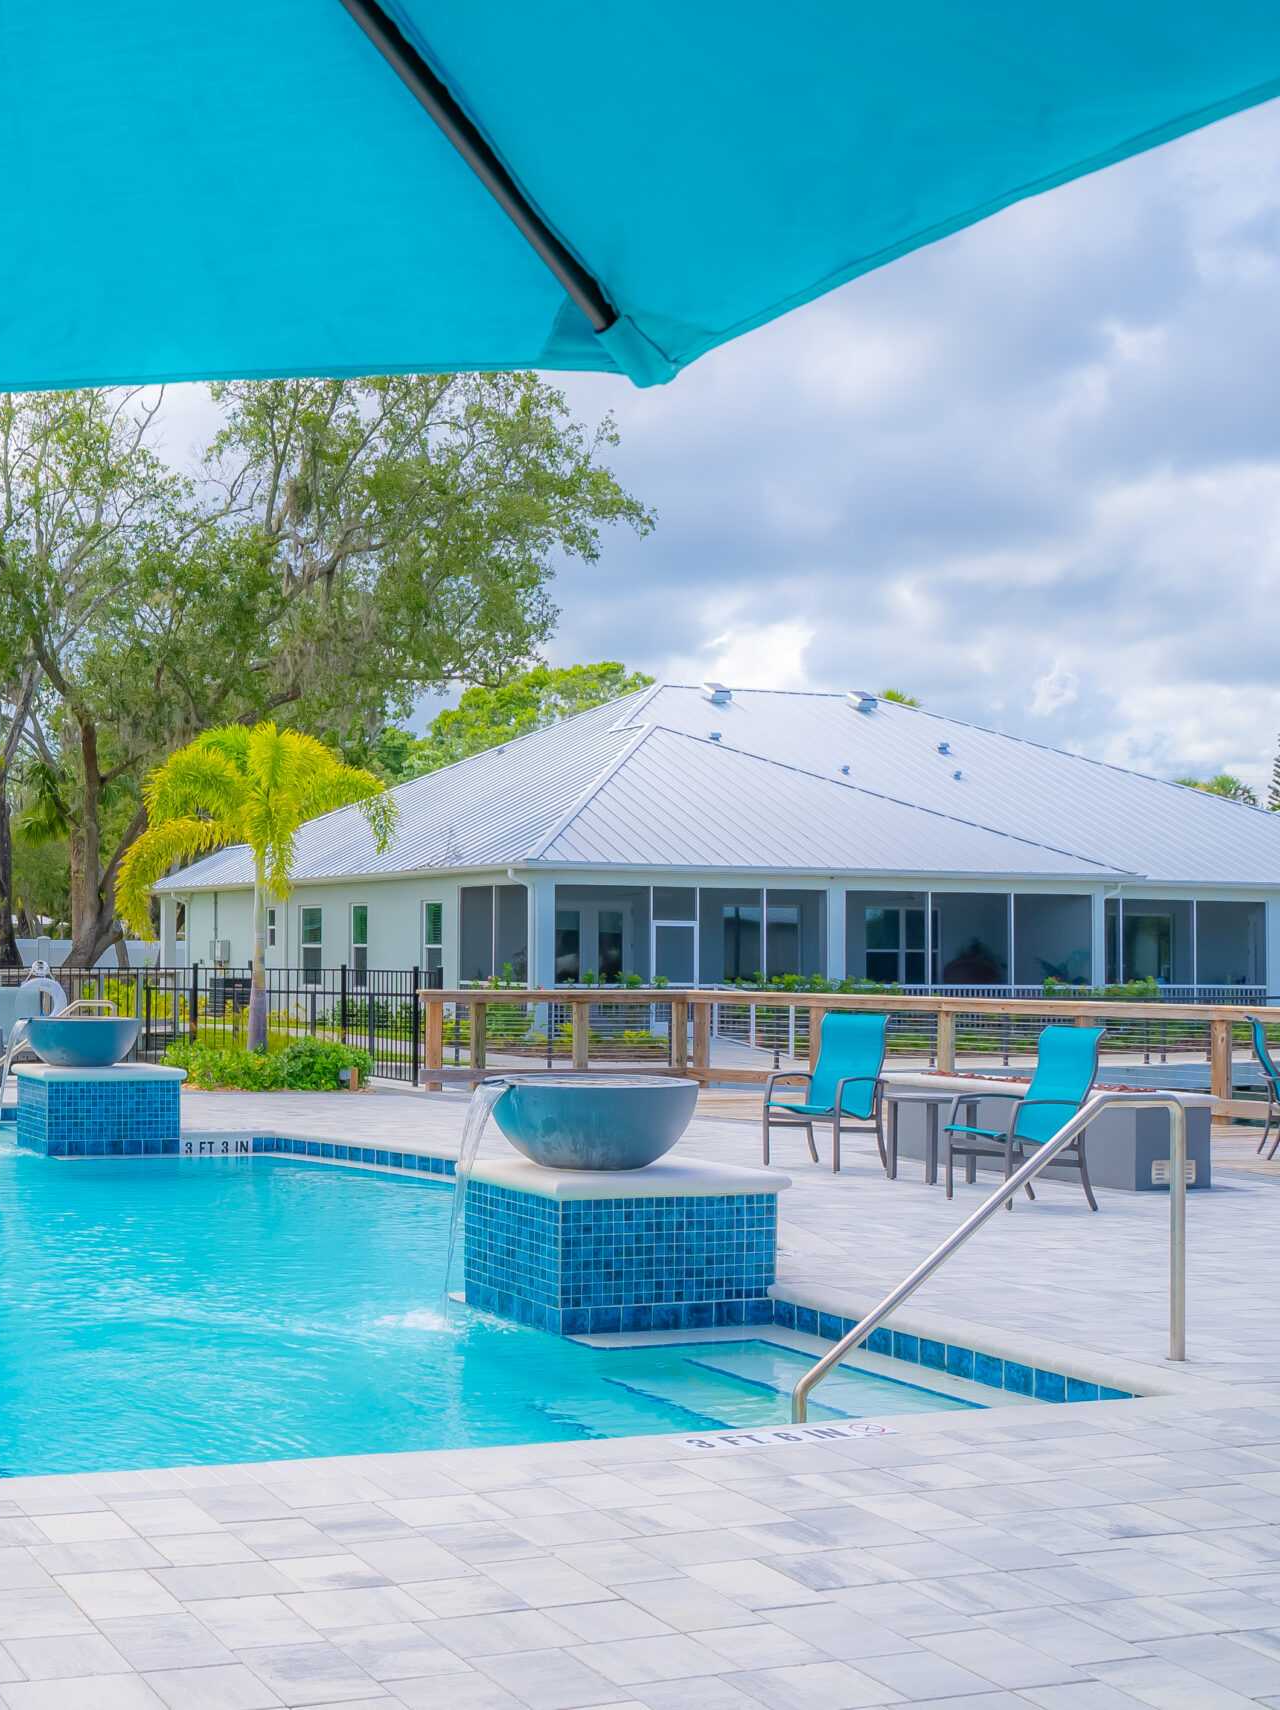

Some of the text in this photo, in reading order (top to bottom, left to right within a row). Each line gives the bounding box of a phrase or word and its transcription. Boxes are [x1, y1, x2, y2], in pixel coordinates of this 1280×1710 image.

[185, 1140, 249, 1154] 3 FT 3 IN
[685, 1439, 716, 1449] 3
[772, 1432, 803, 1442] 6
